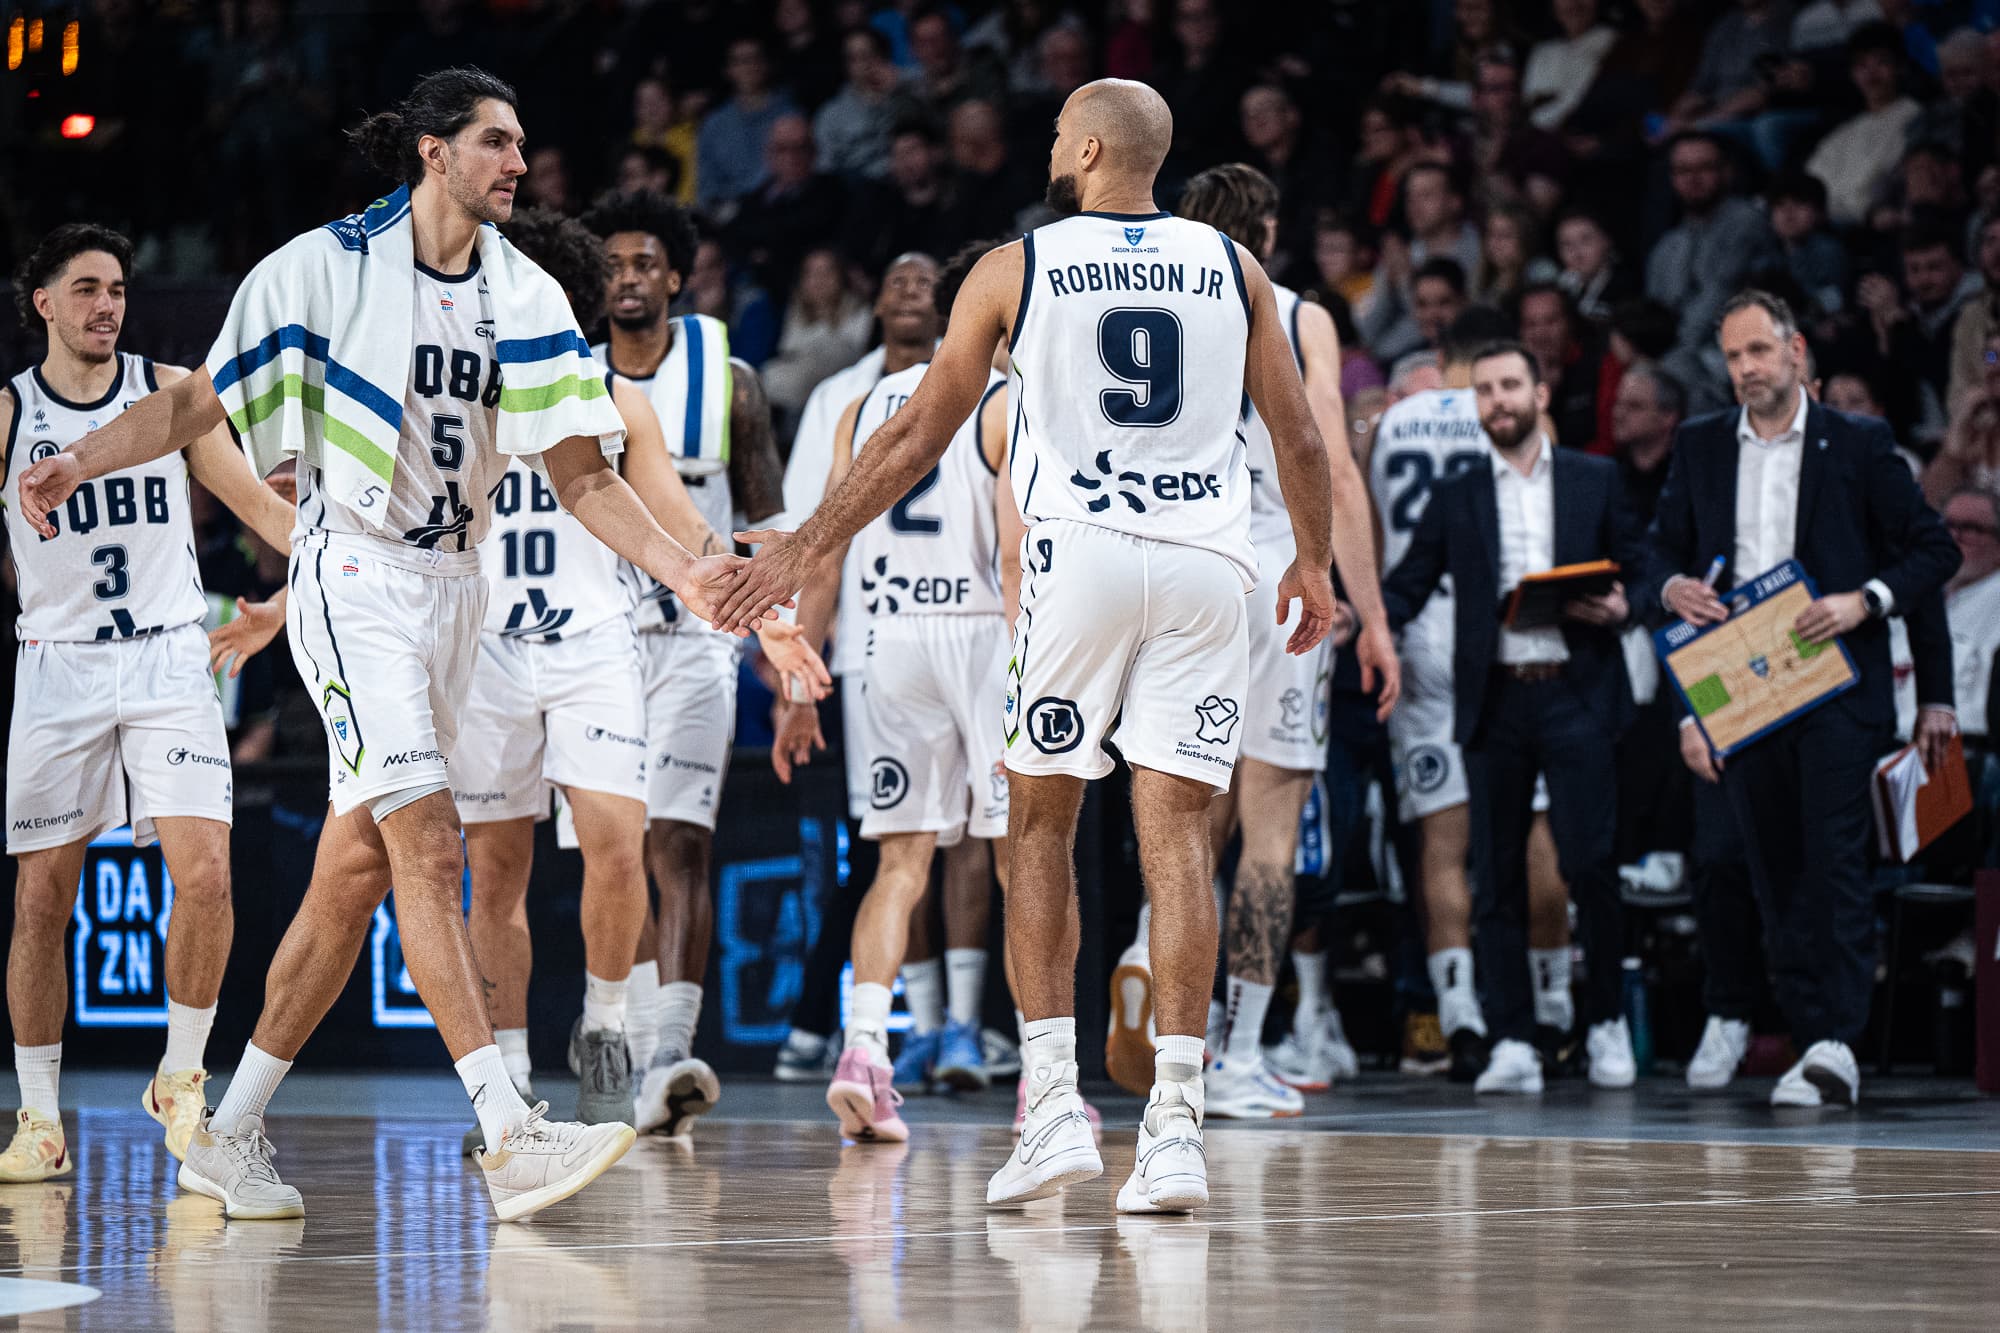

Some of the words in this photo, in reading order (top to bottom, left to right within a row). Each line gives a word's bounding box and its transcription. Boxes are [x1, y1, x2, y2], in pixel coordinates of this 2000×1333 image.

[1048, 262, 1184, 297] ROBINSON
[1192, 267, 1224, 300] JR
[1097, 306, 1184, 428] 9
[431, 412, 465, 472] 5
[359, 485, 384, 507] 5
[91, 543, 130, 601] 3
[500, 528, 557, 579] 10
[191, 753, 230, 769] transd
[411, 749, 444, 765] Energ
[1175, 748, 1234, 769] Hauts-de-Franc
[1177, 741, 1201, 749] Région
[34, 807, 84, 829] Energies
[96, 857, 153, 923] DA
[97, 930, 153, 995] ZN
